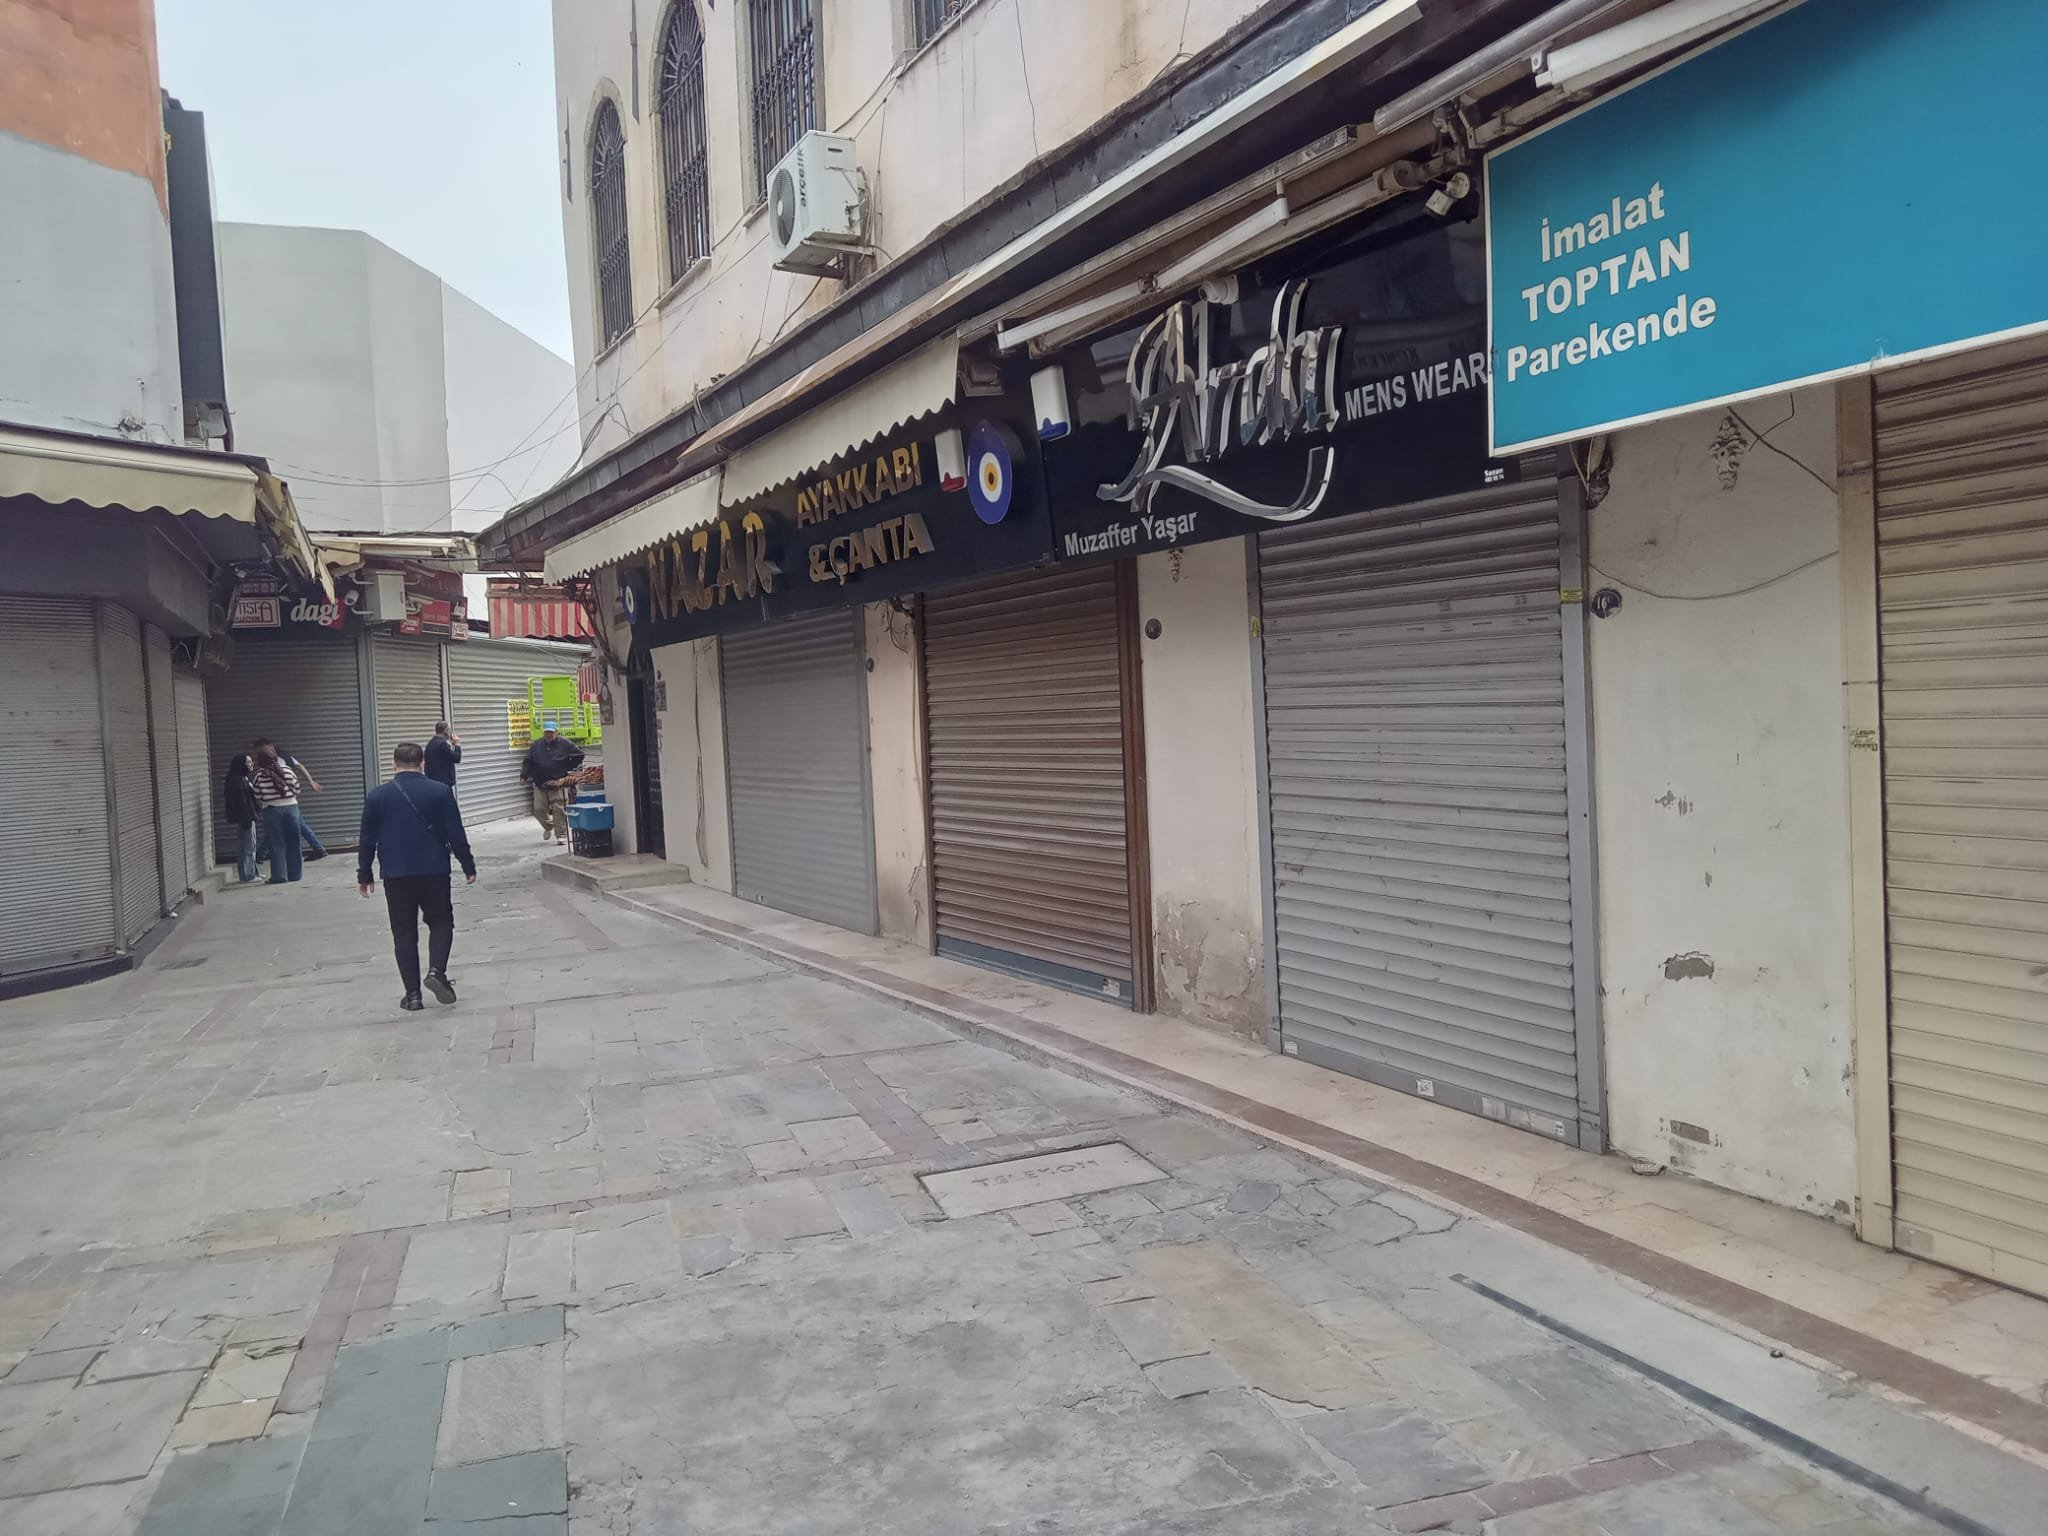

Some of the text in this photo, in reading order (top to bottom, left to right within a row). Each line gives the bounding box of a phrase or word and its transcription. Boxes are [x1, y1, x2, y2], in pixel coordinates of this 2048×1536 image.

[796, 147, 808, 208] arçelik
[1540, 181, 1665, 264] İmalat
[1521, 231, 1690, 322] TOPTAN
[1507, 292, 1716, 382] Parekende
[1344, 375, 1407, 421] MENS
[1411, 351, 1488, 403] WEAR
[797, 441, 922, 528] AYAKKABI
[647, 511, 773, 623] NAZAR
[1064, 511, 1199, 557] Muzaffer Yaşar
